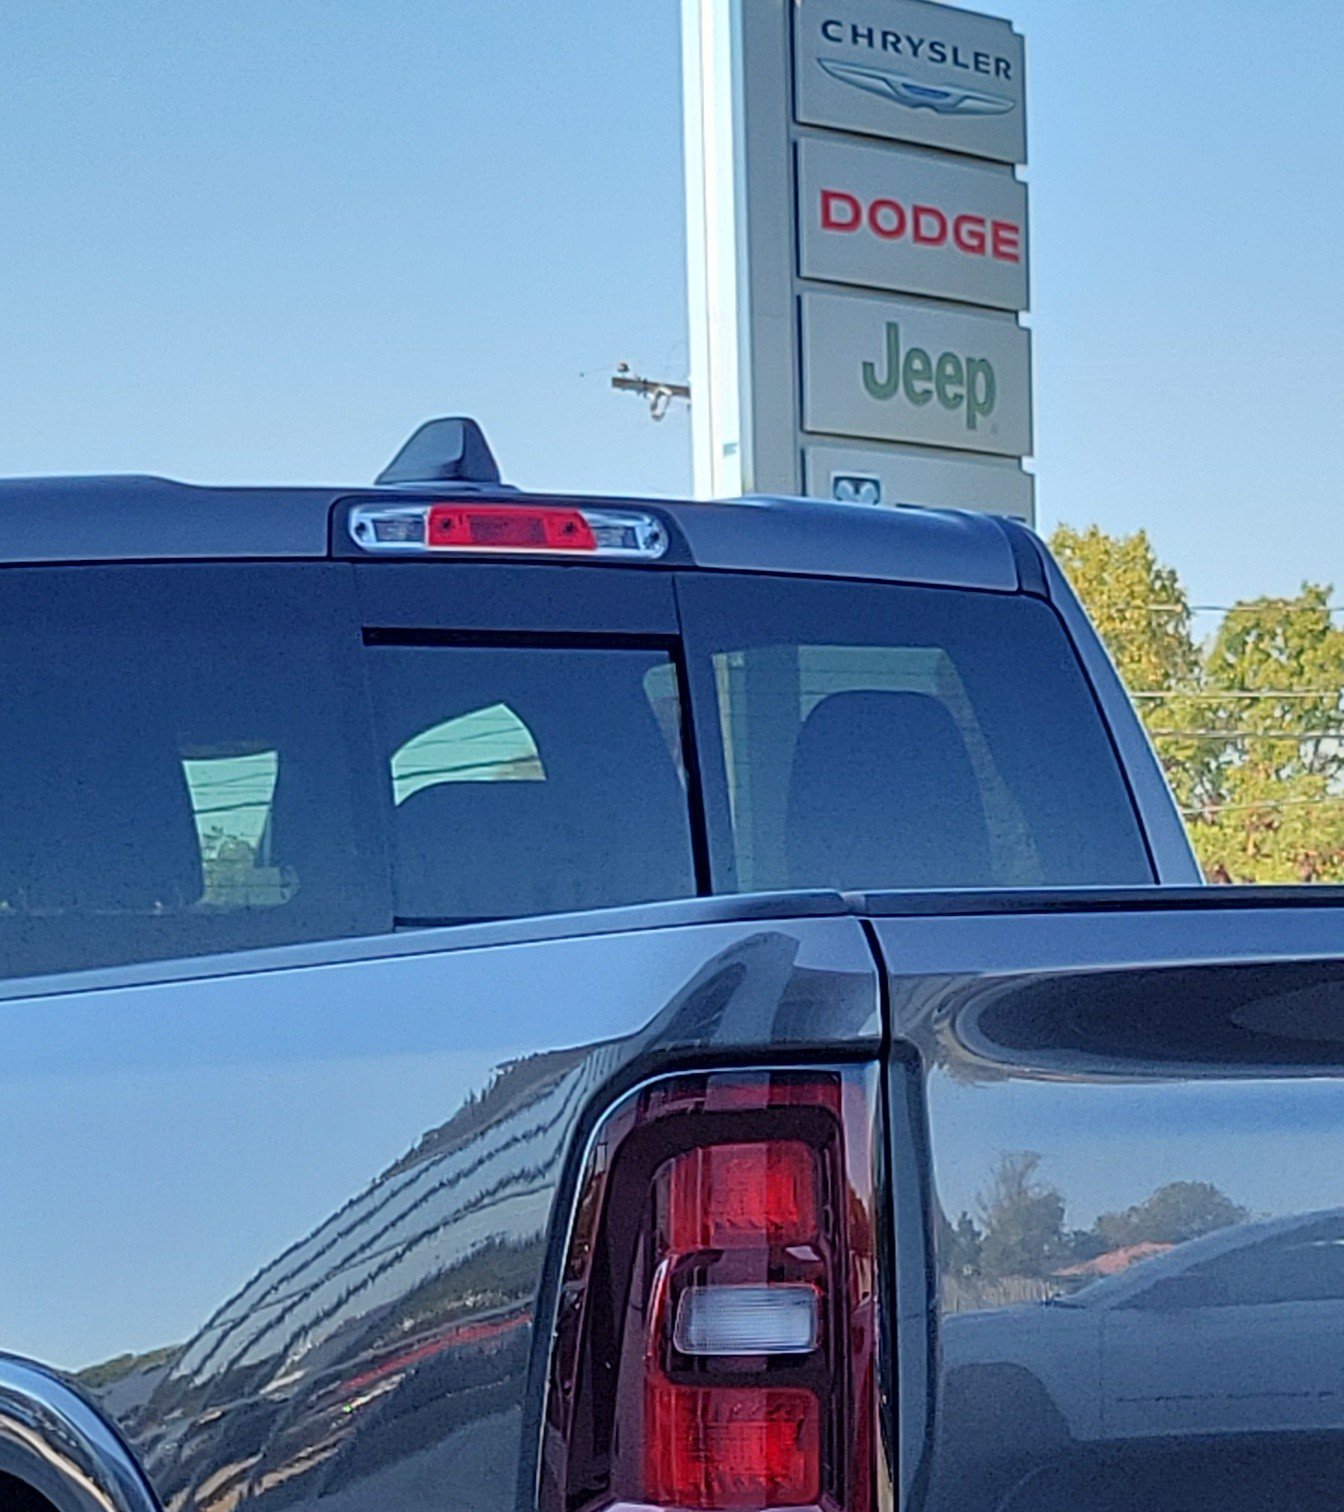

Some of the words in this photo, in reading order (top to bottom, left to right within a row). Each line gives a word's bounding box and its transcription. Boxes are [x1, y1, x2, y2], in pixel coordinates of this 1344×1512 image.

[821, 19, 1013, 81] CHRYSLER
[820, 188, 1020, 264] DODGE
[862, 321, 997, 430] Jeep
